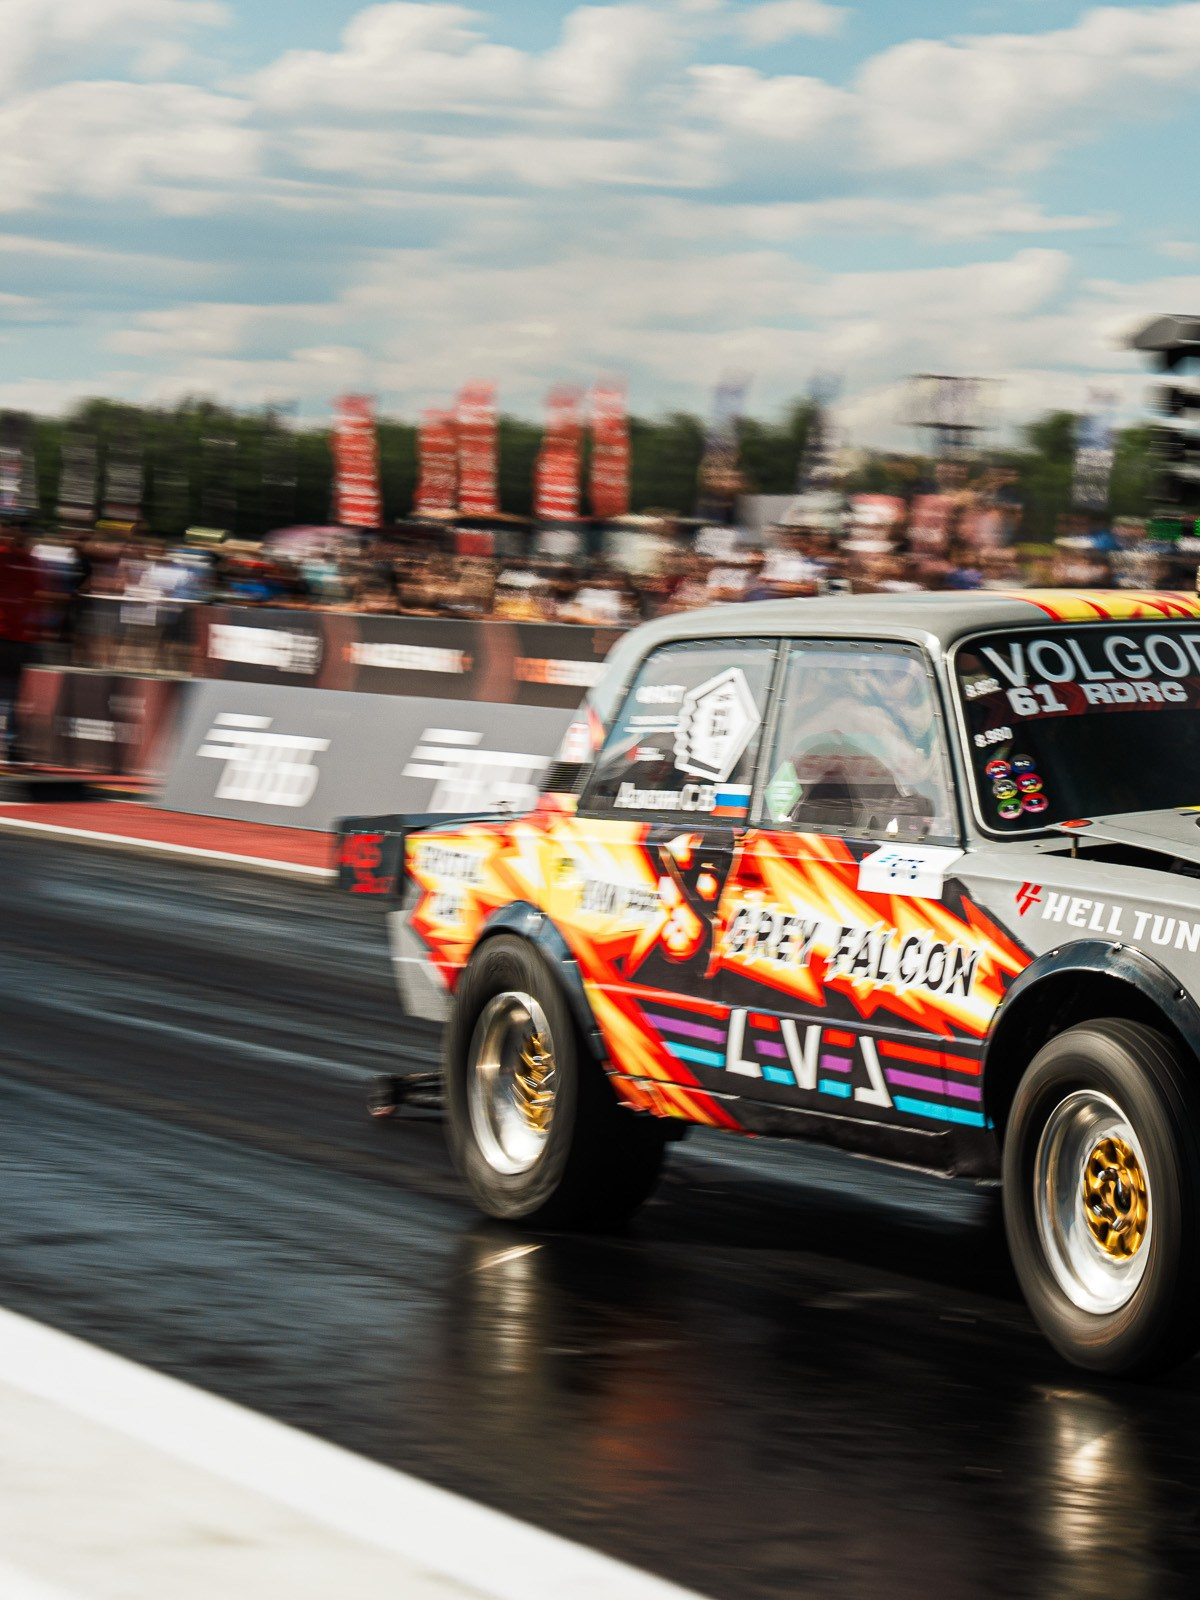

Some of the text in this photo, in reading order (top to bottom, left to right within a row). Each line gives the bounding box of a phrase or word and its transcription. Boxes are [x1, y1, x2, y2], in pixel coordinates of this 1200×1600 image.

[1007, 681, 1189, 716] 61 RDRG
[1040, 891, 1124, 937] HELL
[723, 903, 983, 997] GREY FALCON
